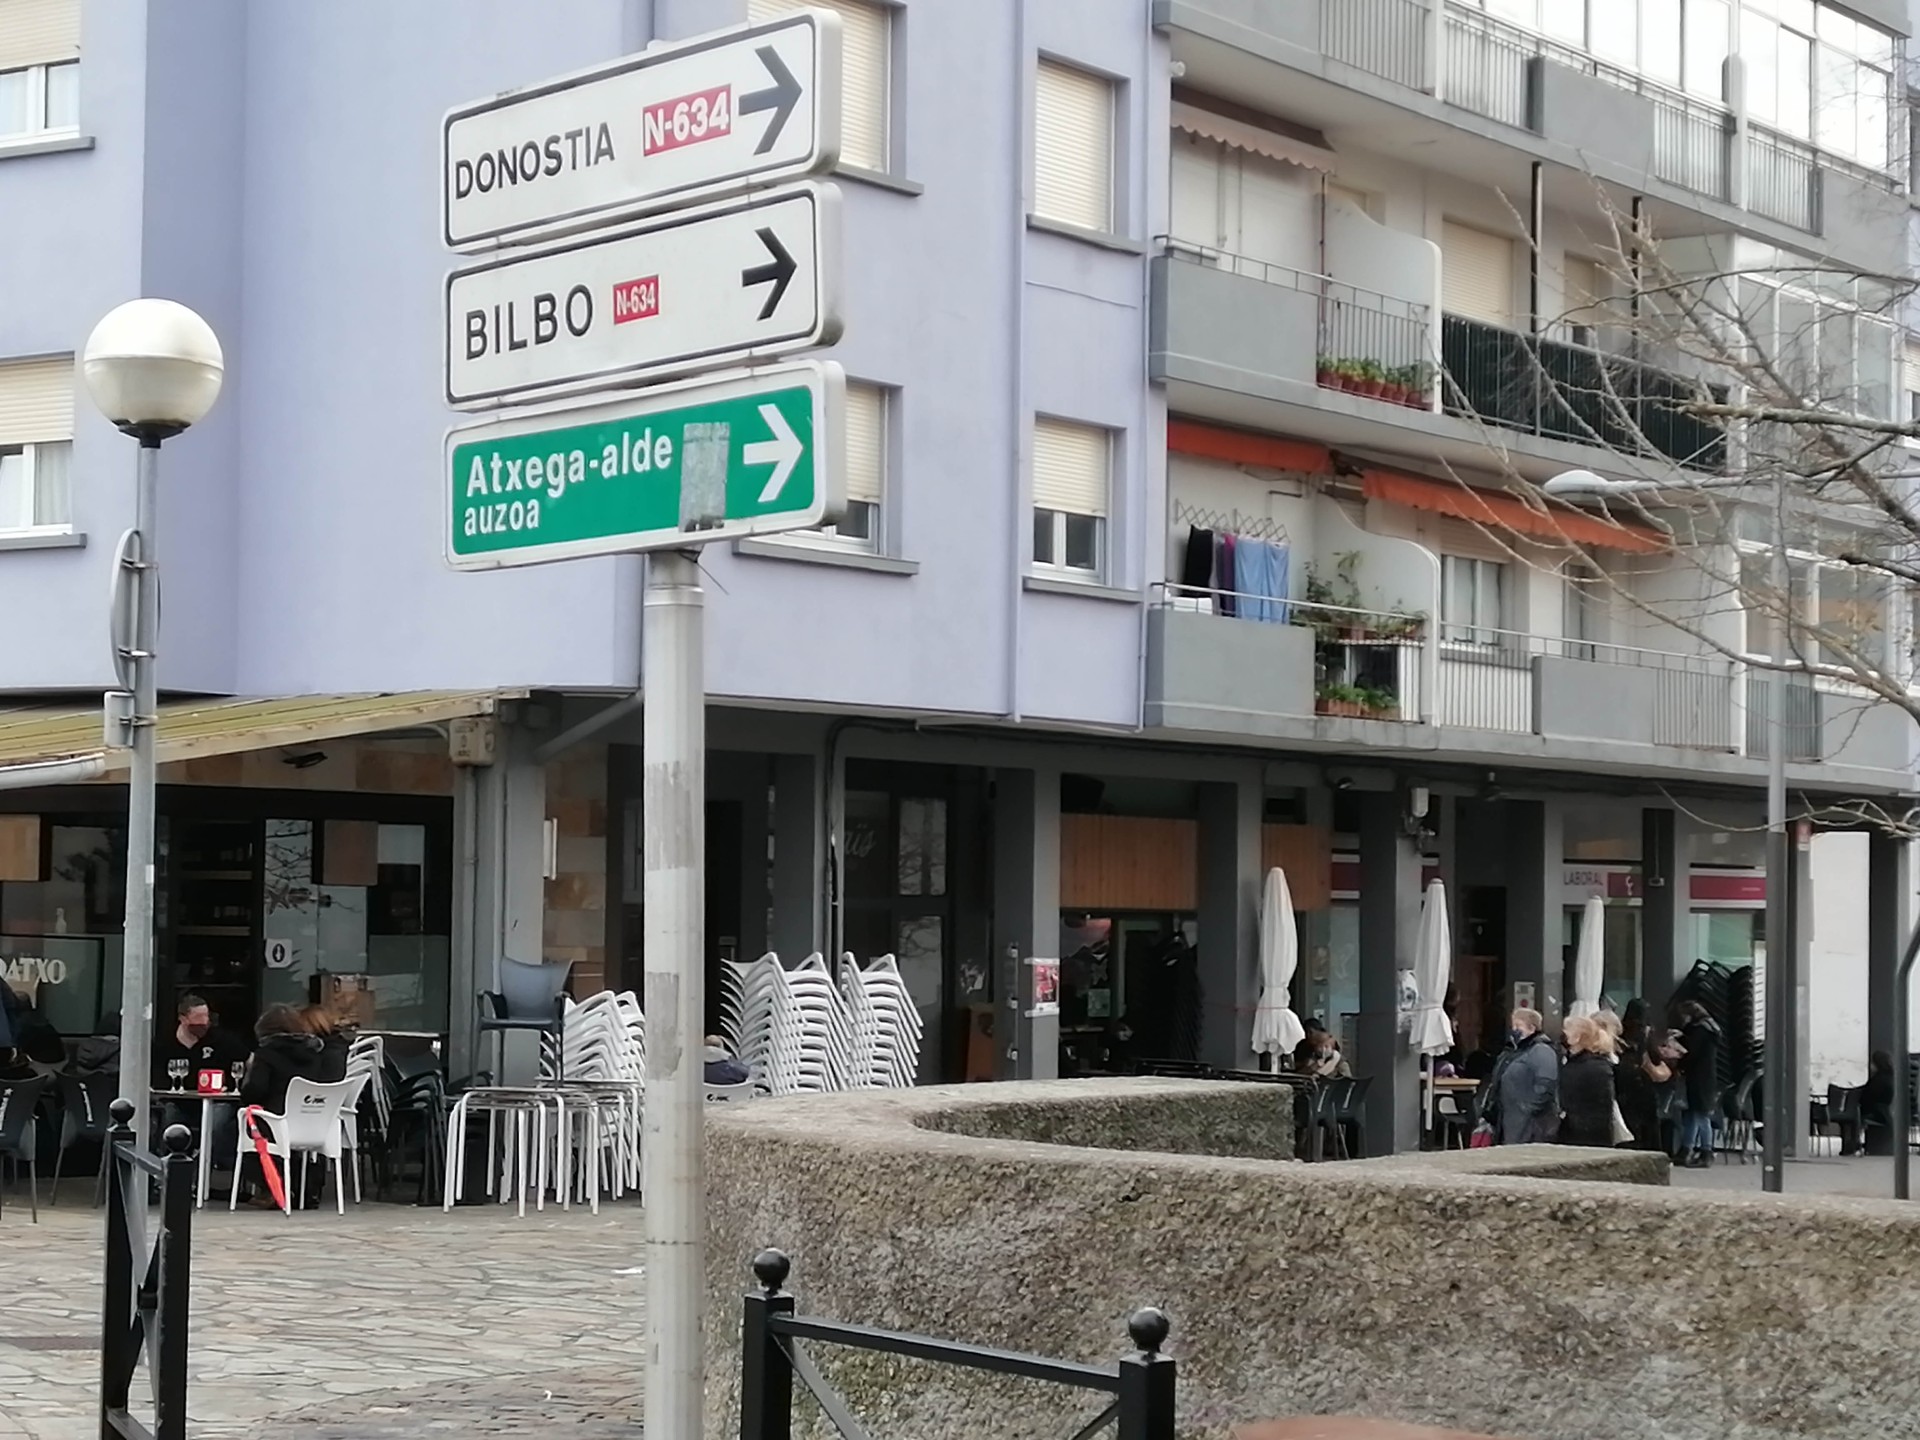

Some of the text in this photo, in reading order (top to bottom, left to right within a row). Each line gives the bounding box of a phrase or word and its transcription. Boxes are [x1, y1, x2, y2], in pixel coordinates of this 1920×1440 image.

[455, 91, 730, 199] DONOSTIA N-634
[466, 282, 656, 360] BILBO N-634
[466, 427, 673, 498] Atxega-alde
[464, 498, 540, 536] auzoa
